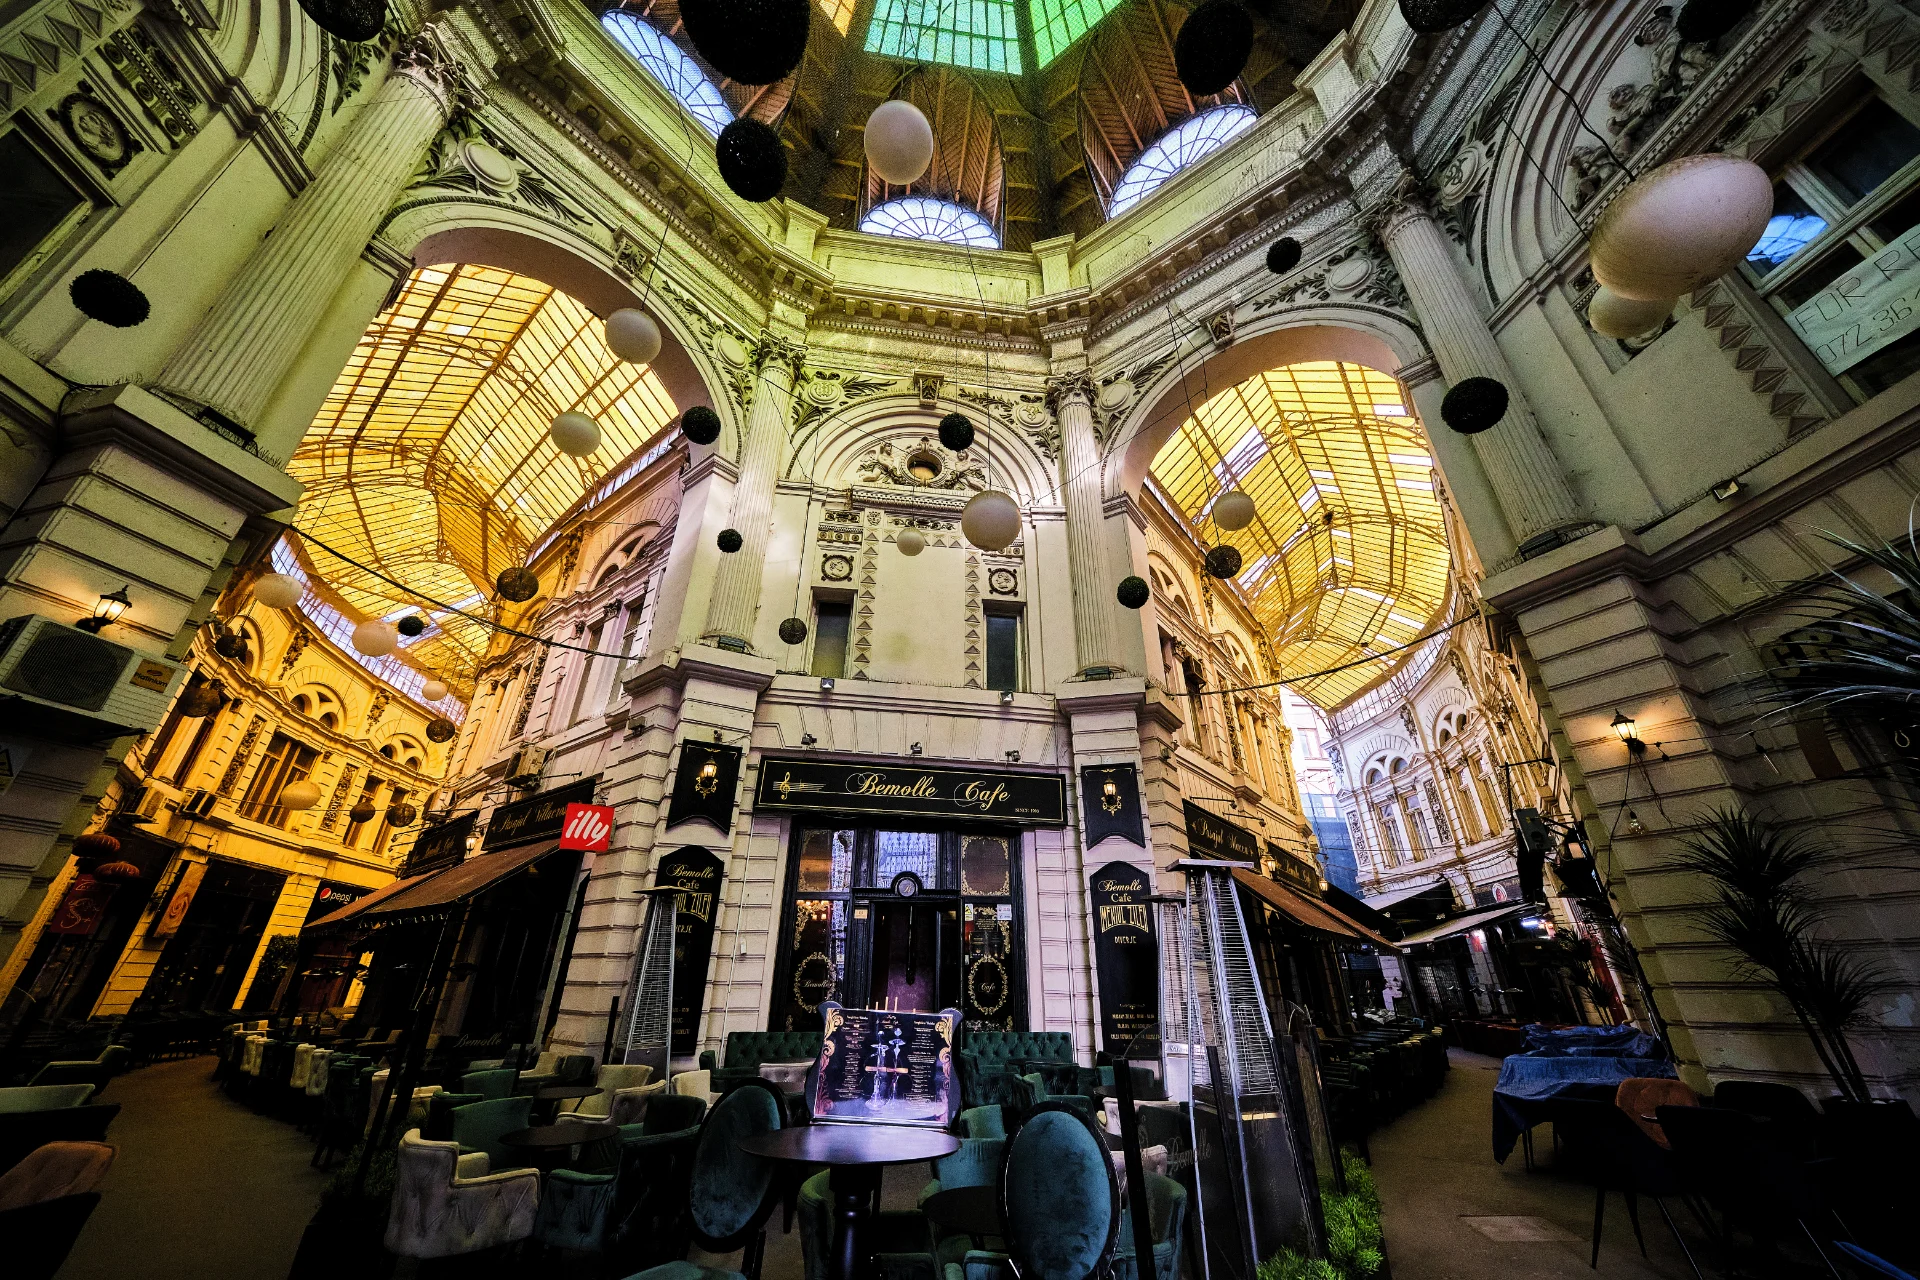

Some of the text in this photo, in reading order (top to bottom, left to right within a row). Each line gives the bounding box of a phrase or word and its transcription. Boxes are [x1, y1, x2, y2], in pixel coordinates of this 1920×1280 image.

[1795, 277, 1865, 334] FOR
[846, 772, 1010, 810] Bemolle Cafe
[566, 810, 610, 847] illy
[666, 864, 715, 879] Bemolle
[677, 878, 700, 889] Cafe
[1098, 879, 1142, 892] Bemolle
[329, 892, 352, 904] pepsi
[1110, 893, 1132, 903] Cafe
[979, 982, 996, 993] Cafe
[453, 1032, 503, 1048] Bemolle
[1167, 1128, 1212, 1176] Bemlle
